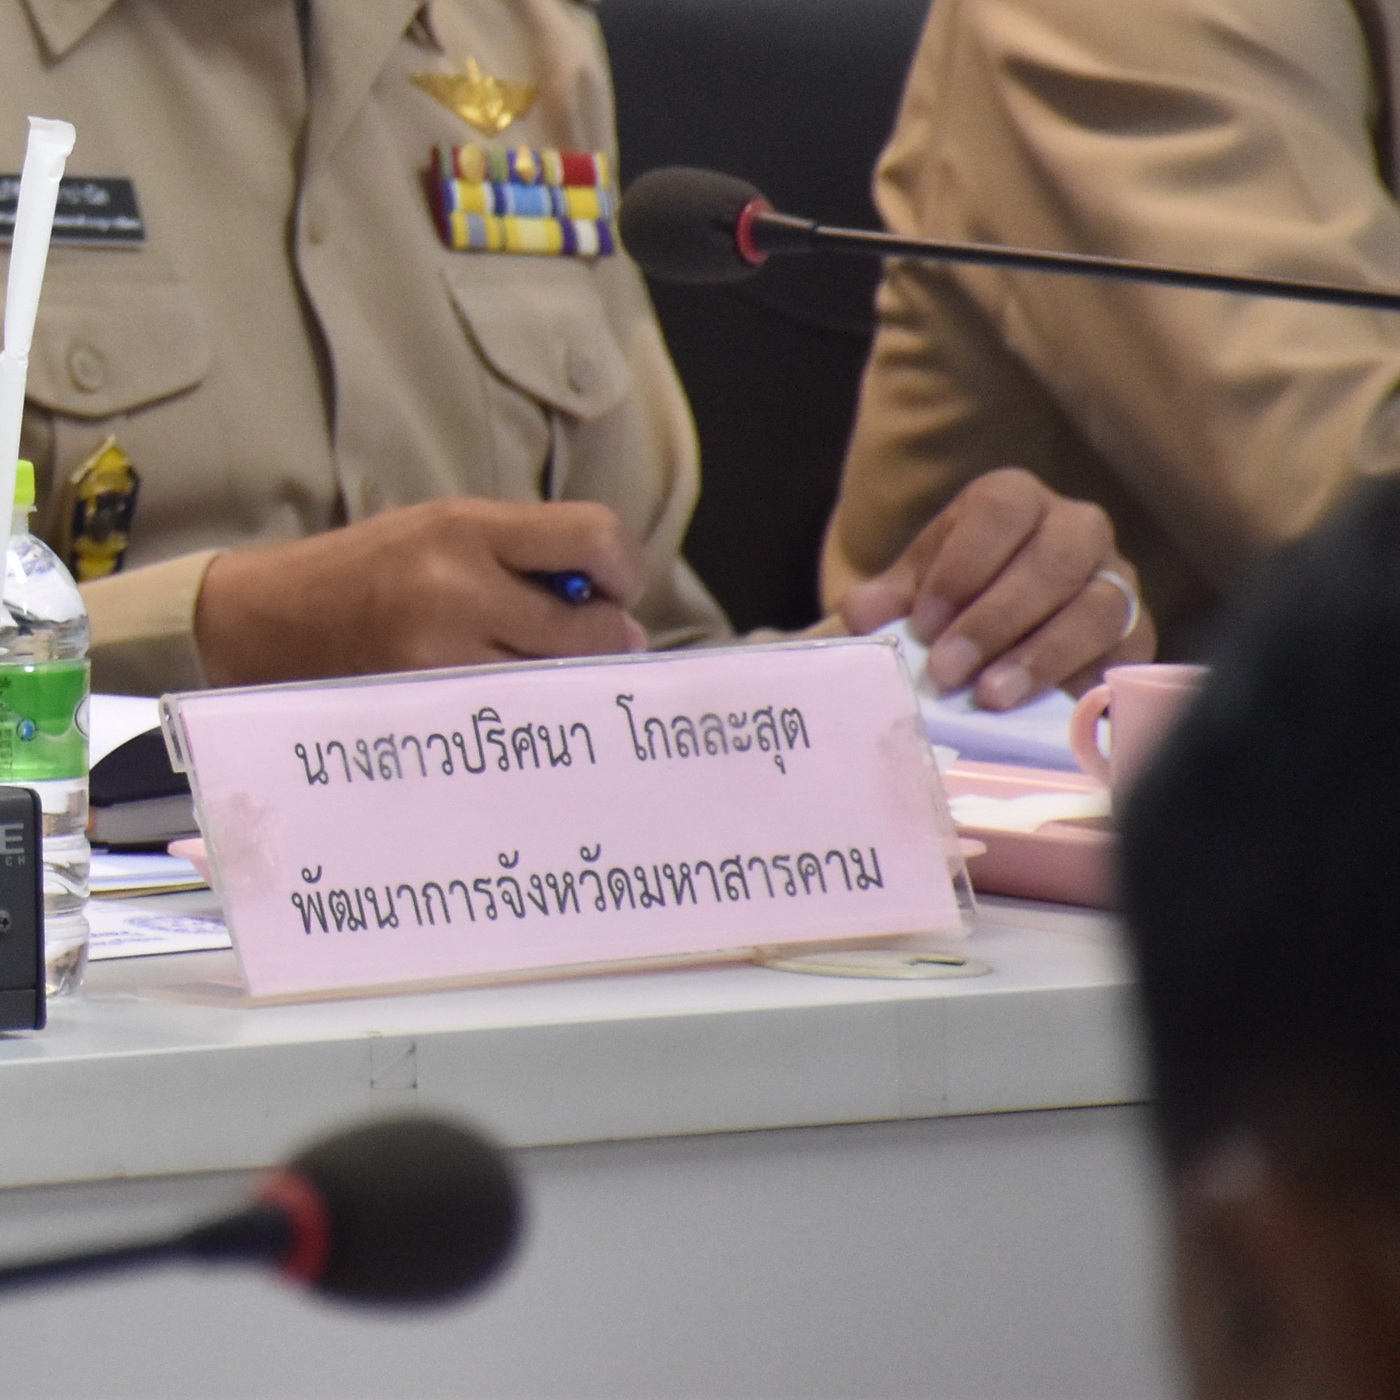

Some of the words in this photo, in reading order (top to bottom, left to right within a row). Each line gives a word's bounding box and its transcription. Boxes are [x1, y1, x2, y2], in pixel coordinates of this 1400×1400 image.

[294, 706, 597, 786] นางสาวปริศนา
[615, 693, 811, 775] โกลละสุต
[291, 844, 885, 935] พัฒนาการจังหวัดมหาสารคาม
